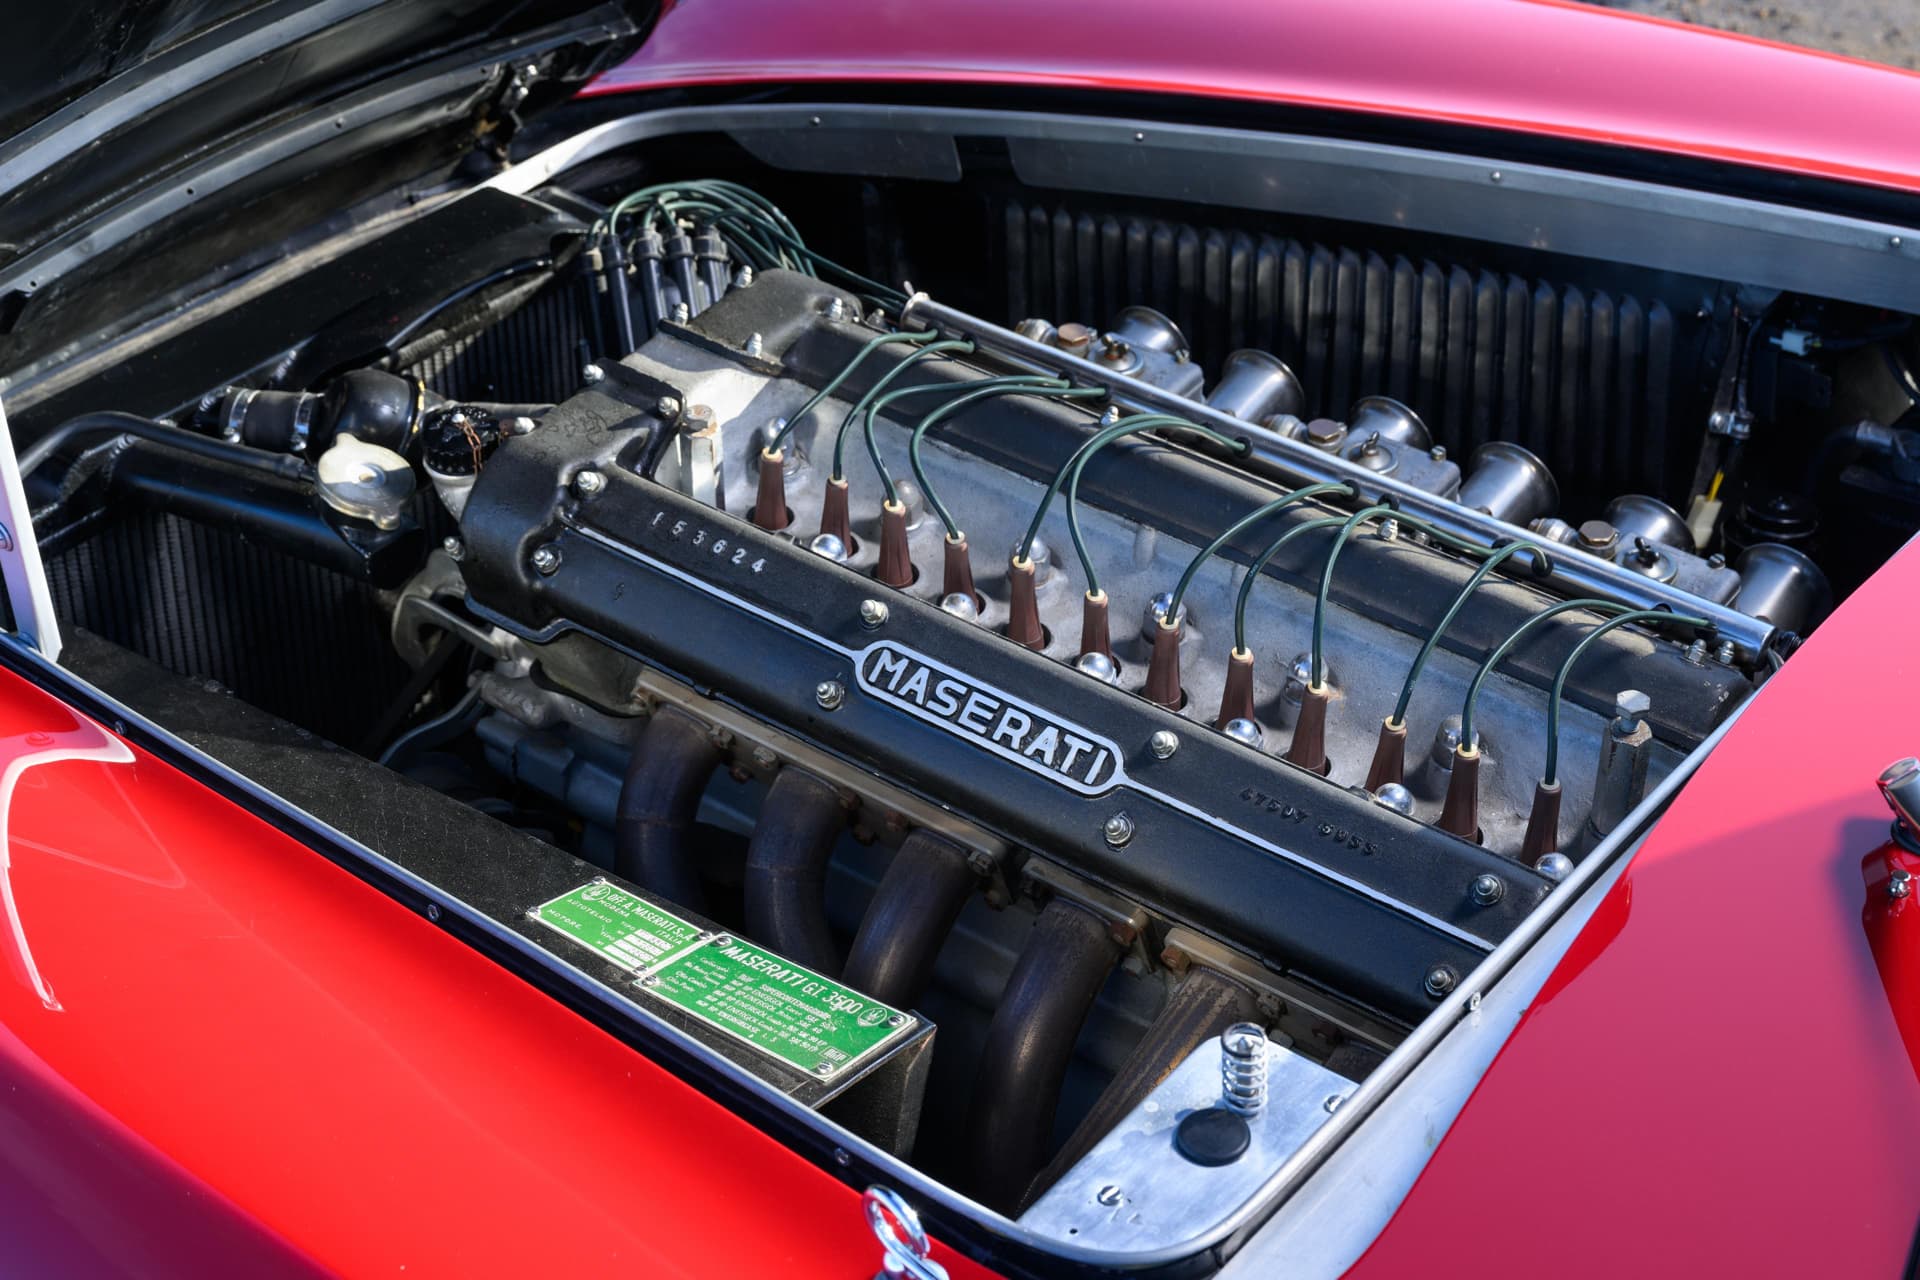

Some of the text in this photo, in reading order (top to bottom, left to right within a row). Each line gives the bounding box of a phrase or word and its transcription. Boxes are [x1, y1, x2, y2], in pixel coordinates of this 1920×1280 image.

[867, 647, 1108, 785] MASERATI
[566, 898, 613, 923] AUTOTELAIO
[654, 929, 684, 944] ITALIA
[717, 944, 809, 987] MASERATI
[820, 991, 865, 1014] 3500
